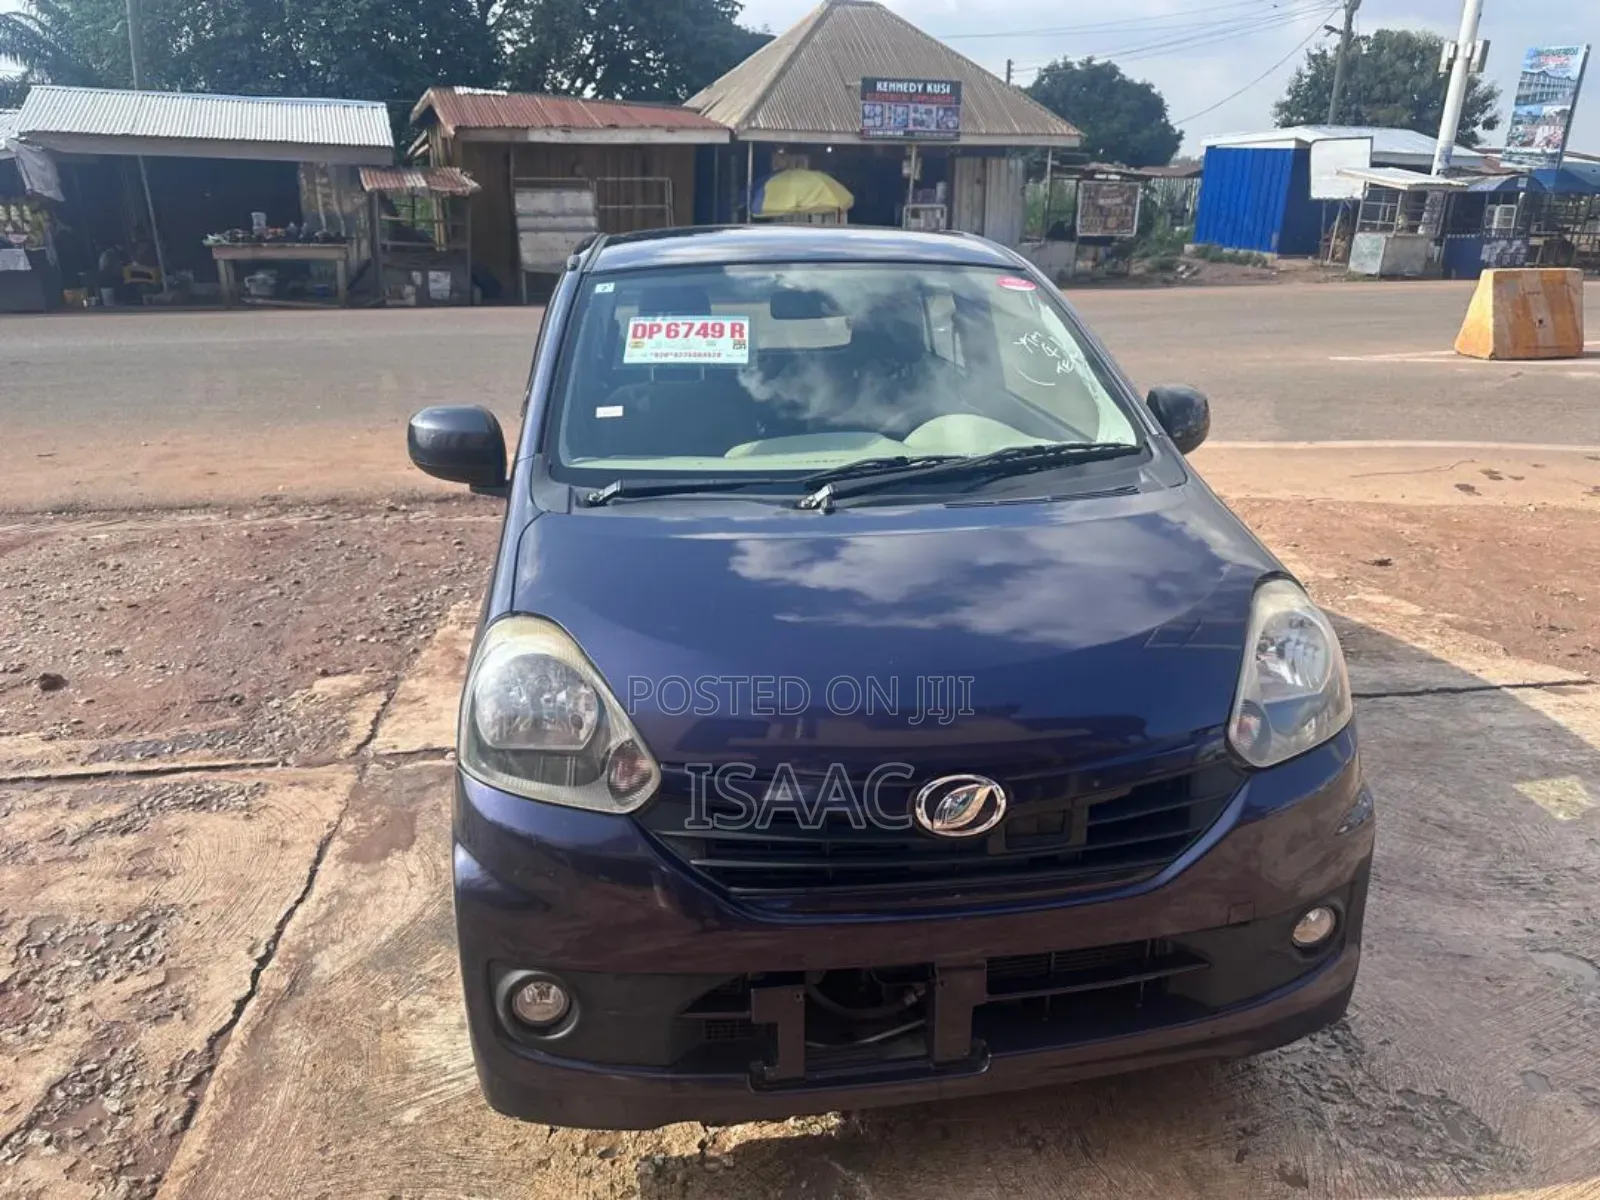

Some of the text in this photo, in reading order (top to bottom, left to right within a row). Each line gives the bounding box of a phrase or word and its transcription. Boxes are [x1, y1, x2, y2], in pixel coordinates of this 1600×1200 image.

[876, 81, 951, 94] KENNEDY KUSI
[631, 322, 745, 340] DP 6749 R
